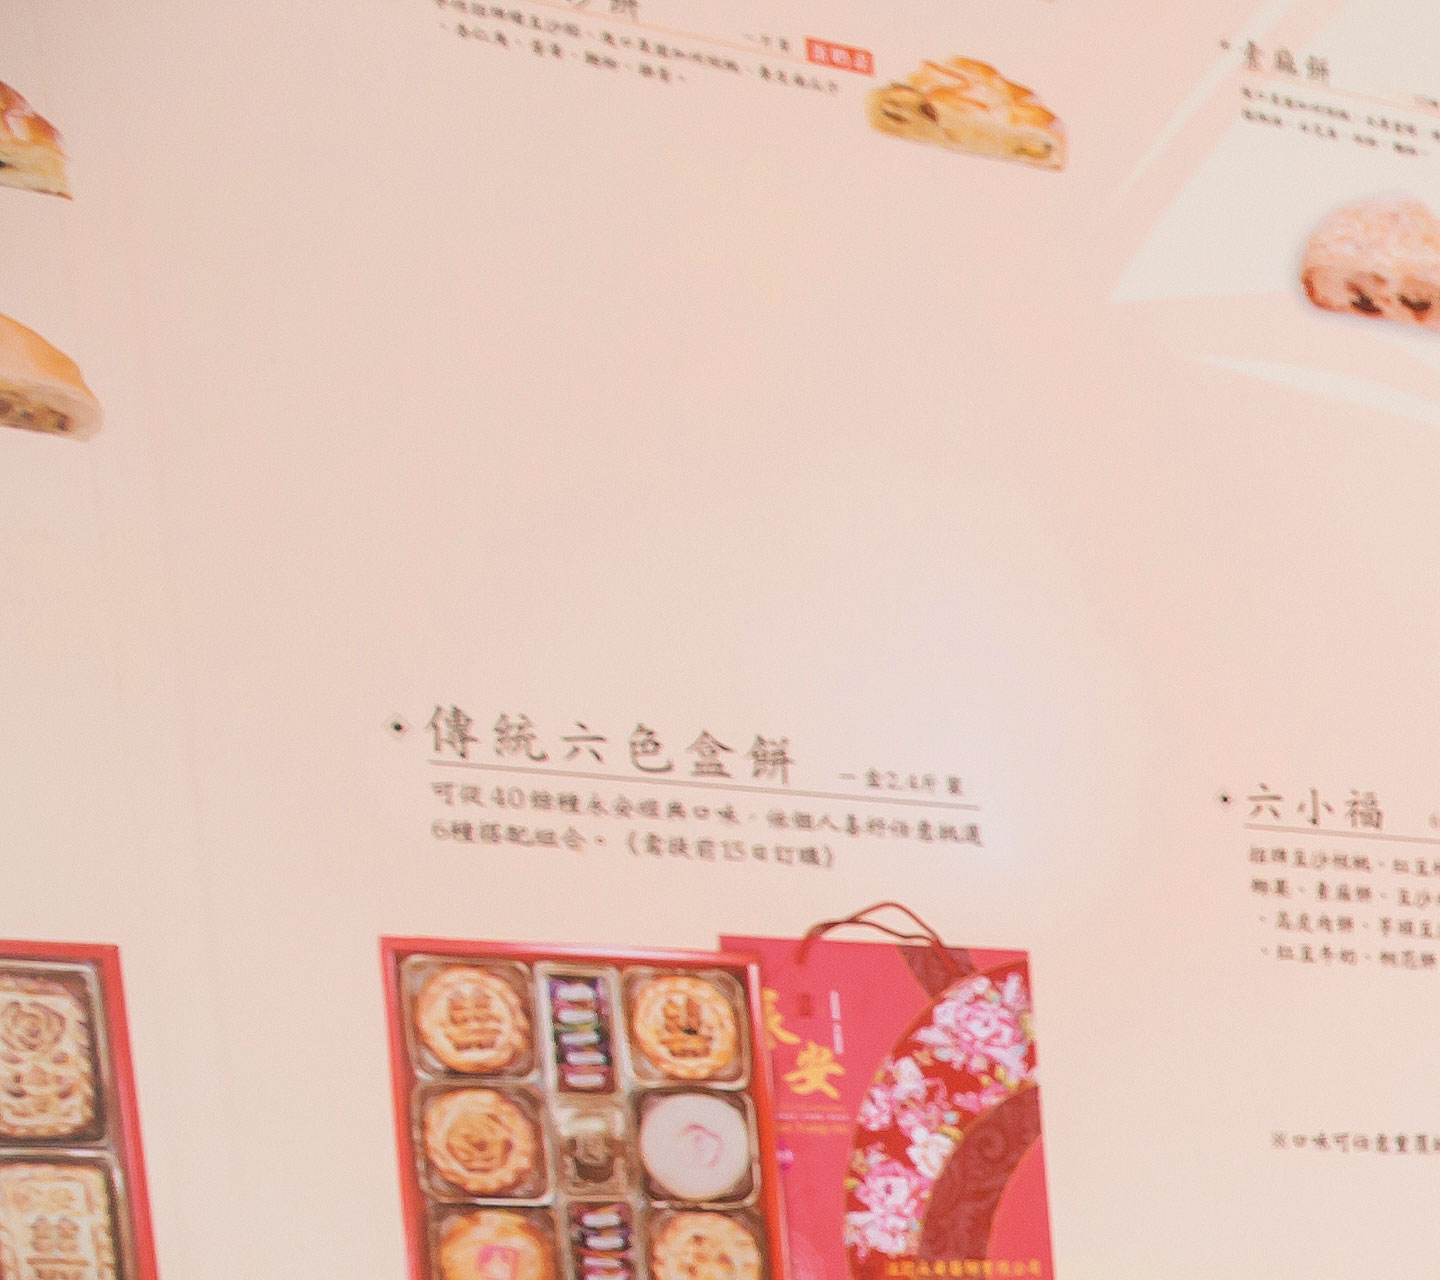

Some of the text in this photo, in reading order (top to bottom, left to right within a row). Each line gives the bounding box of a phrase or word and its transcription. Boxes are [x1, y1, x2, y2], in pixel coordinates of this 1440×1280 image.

[424, 703, 797, 786] 傳統六色盒餅
[1248, 783, 1384, 830] 六小福
